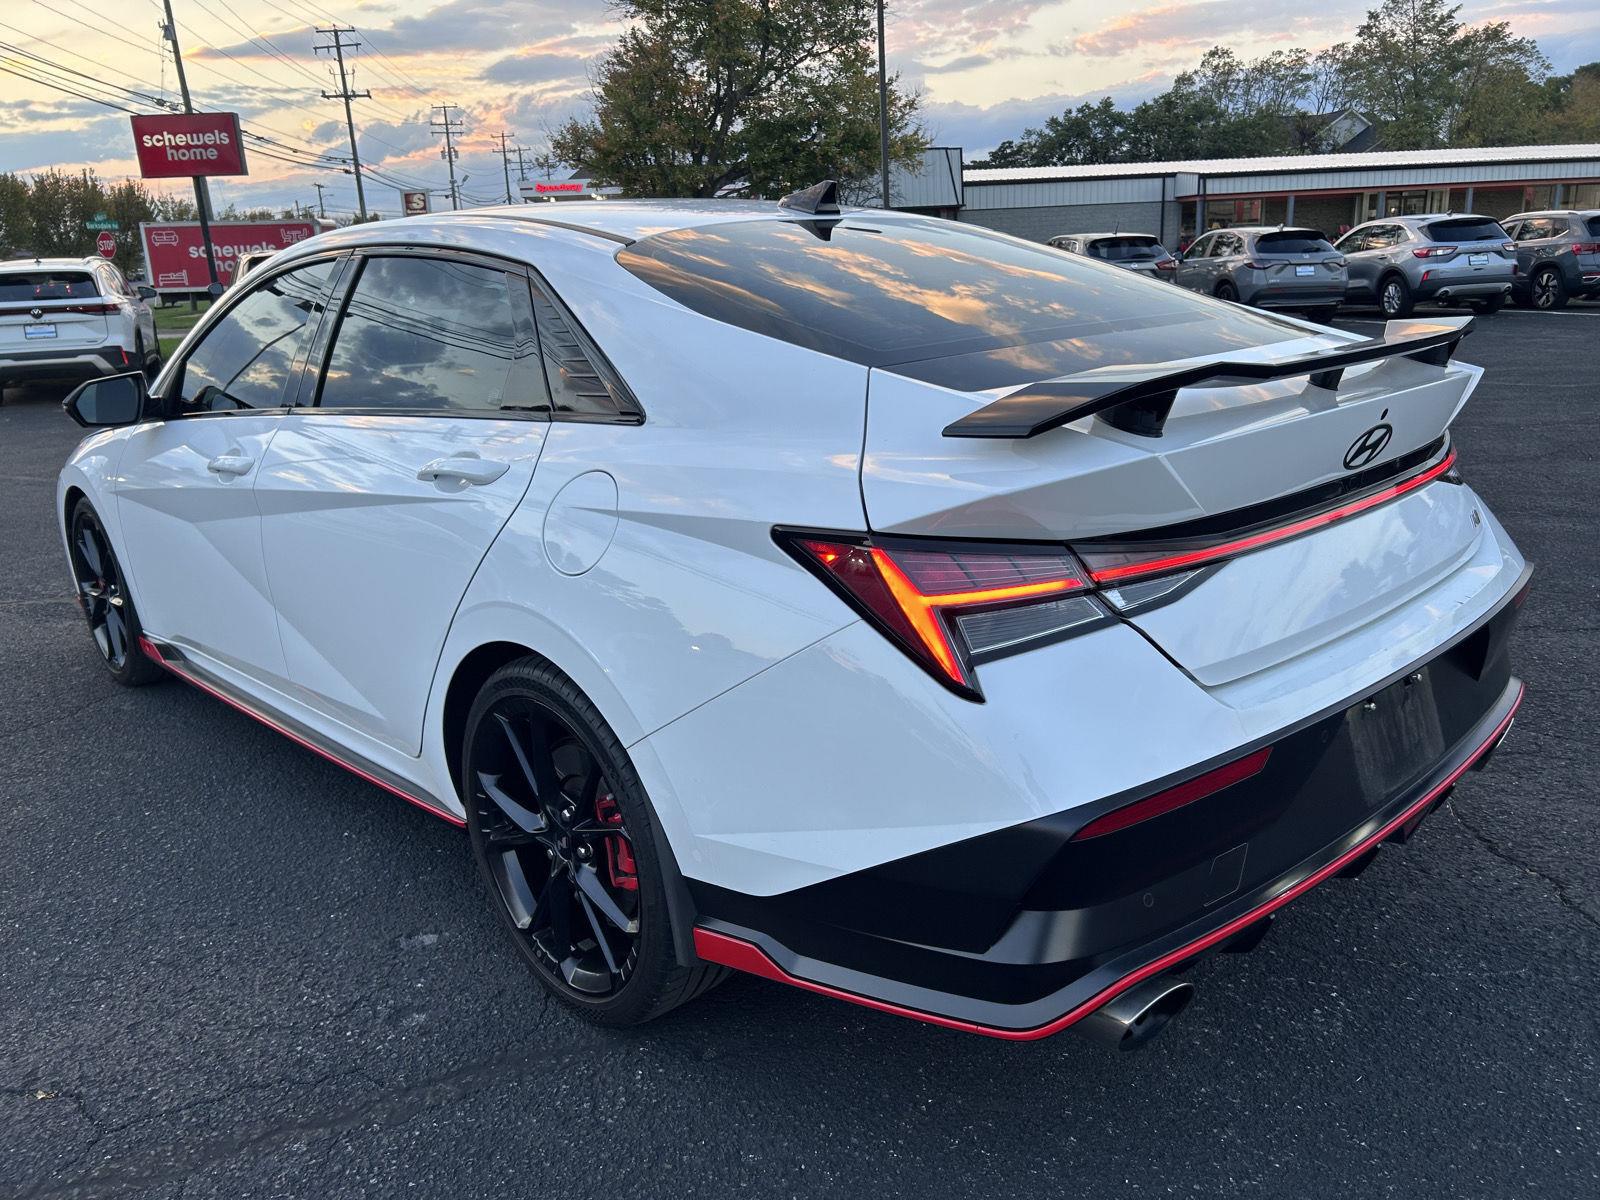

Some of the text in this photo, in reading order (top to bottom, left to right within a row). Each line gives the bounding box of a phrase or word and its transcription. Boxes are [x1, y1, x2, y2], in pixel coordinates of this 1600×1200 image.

[142, 129, 230, 147] schewels
[166, 145, 218, 161] home
[535, 182, 583, 193] Speedway
[98, 239, 114, 251] STOP
[213, 257, 236, 273] ho
